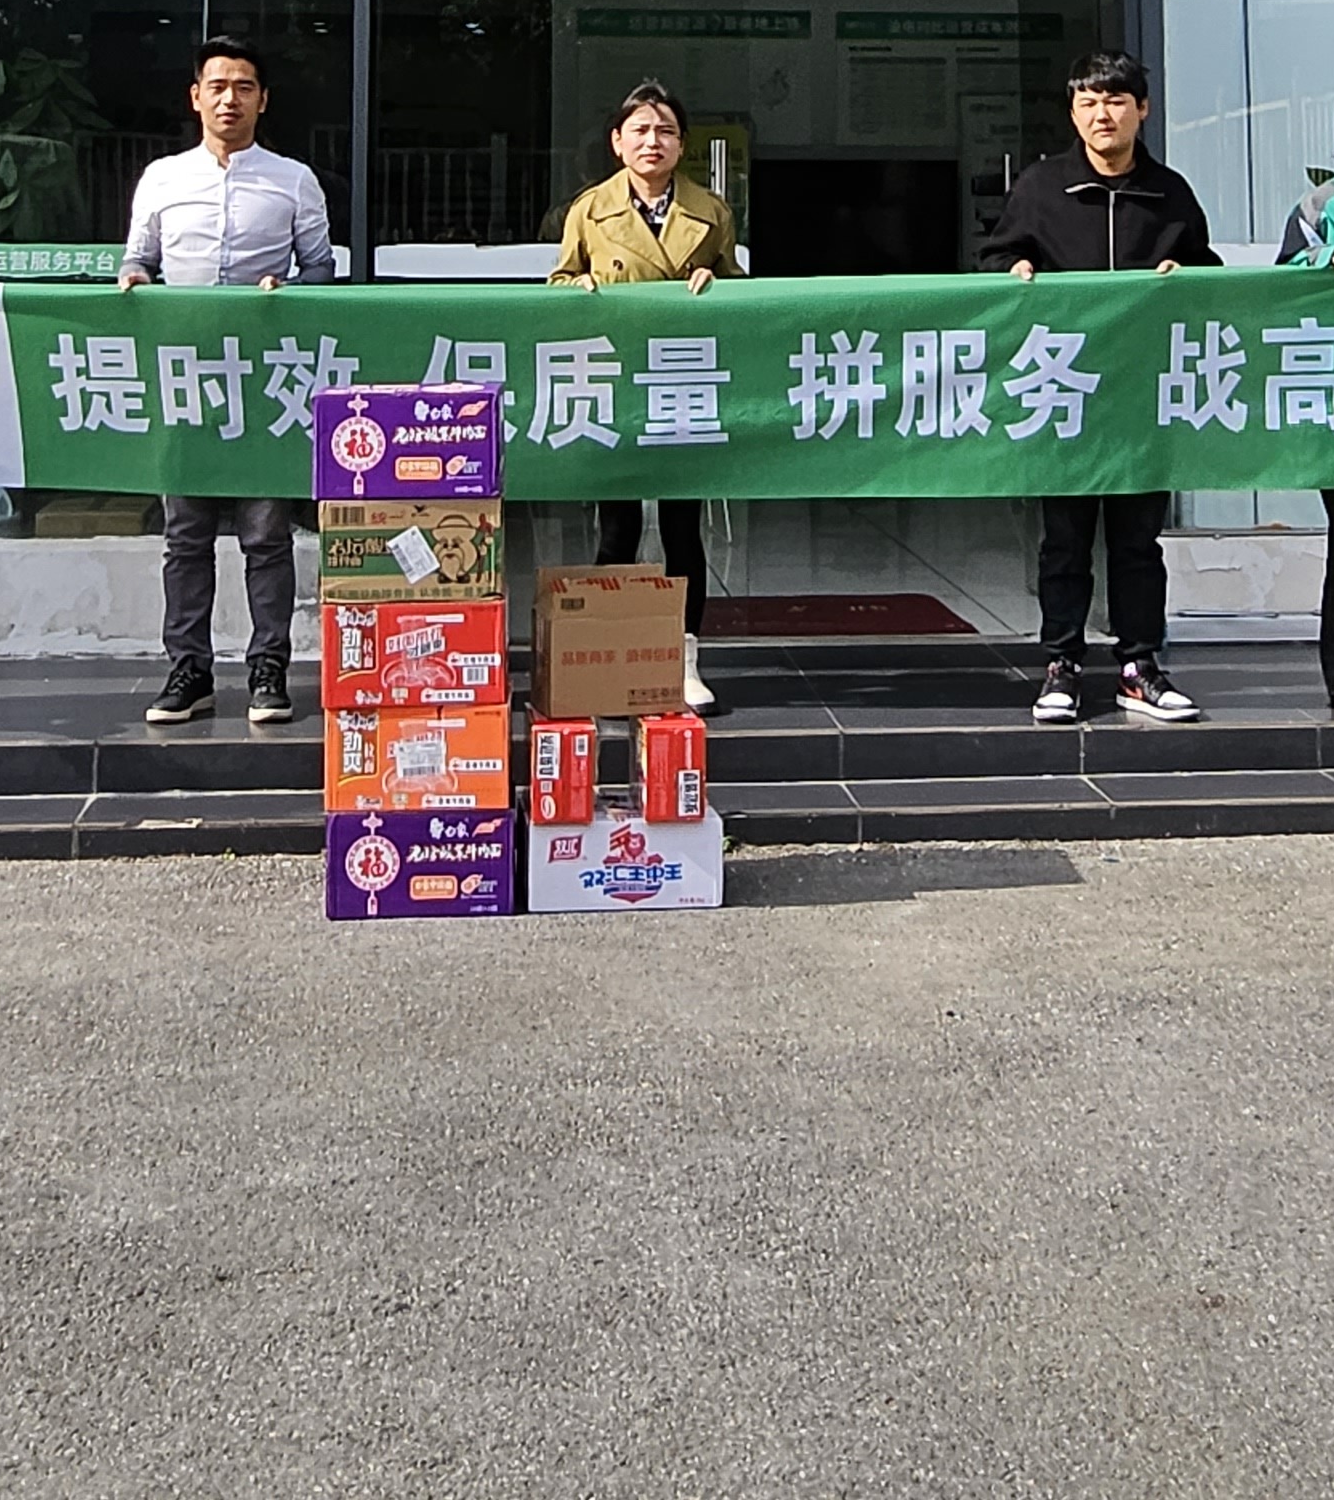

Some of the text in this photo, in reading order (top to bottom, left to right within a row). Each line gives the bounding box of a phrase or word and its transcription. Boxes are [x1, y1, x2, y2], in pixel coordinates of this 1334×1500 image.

[48, 332, 361, 440] 提时效
[787, 322, 1102, 442] 拼服务
[578, 862, 684, 889] 双汇王中王
